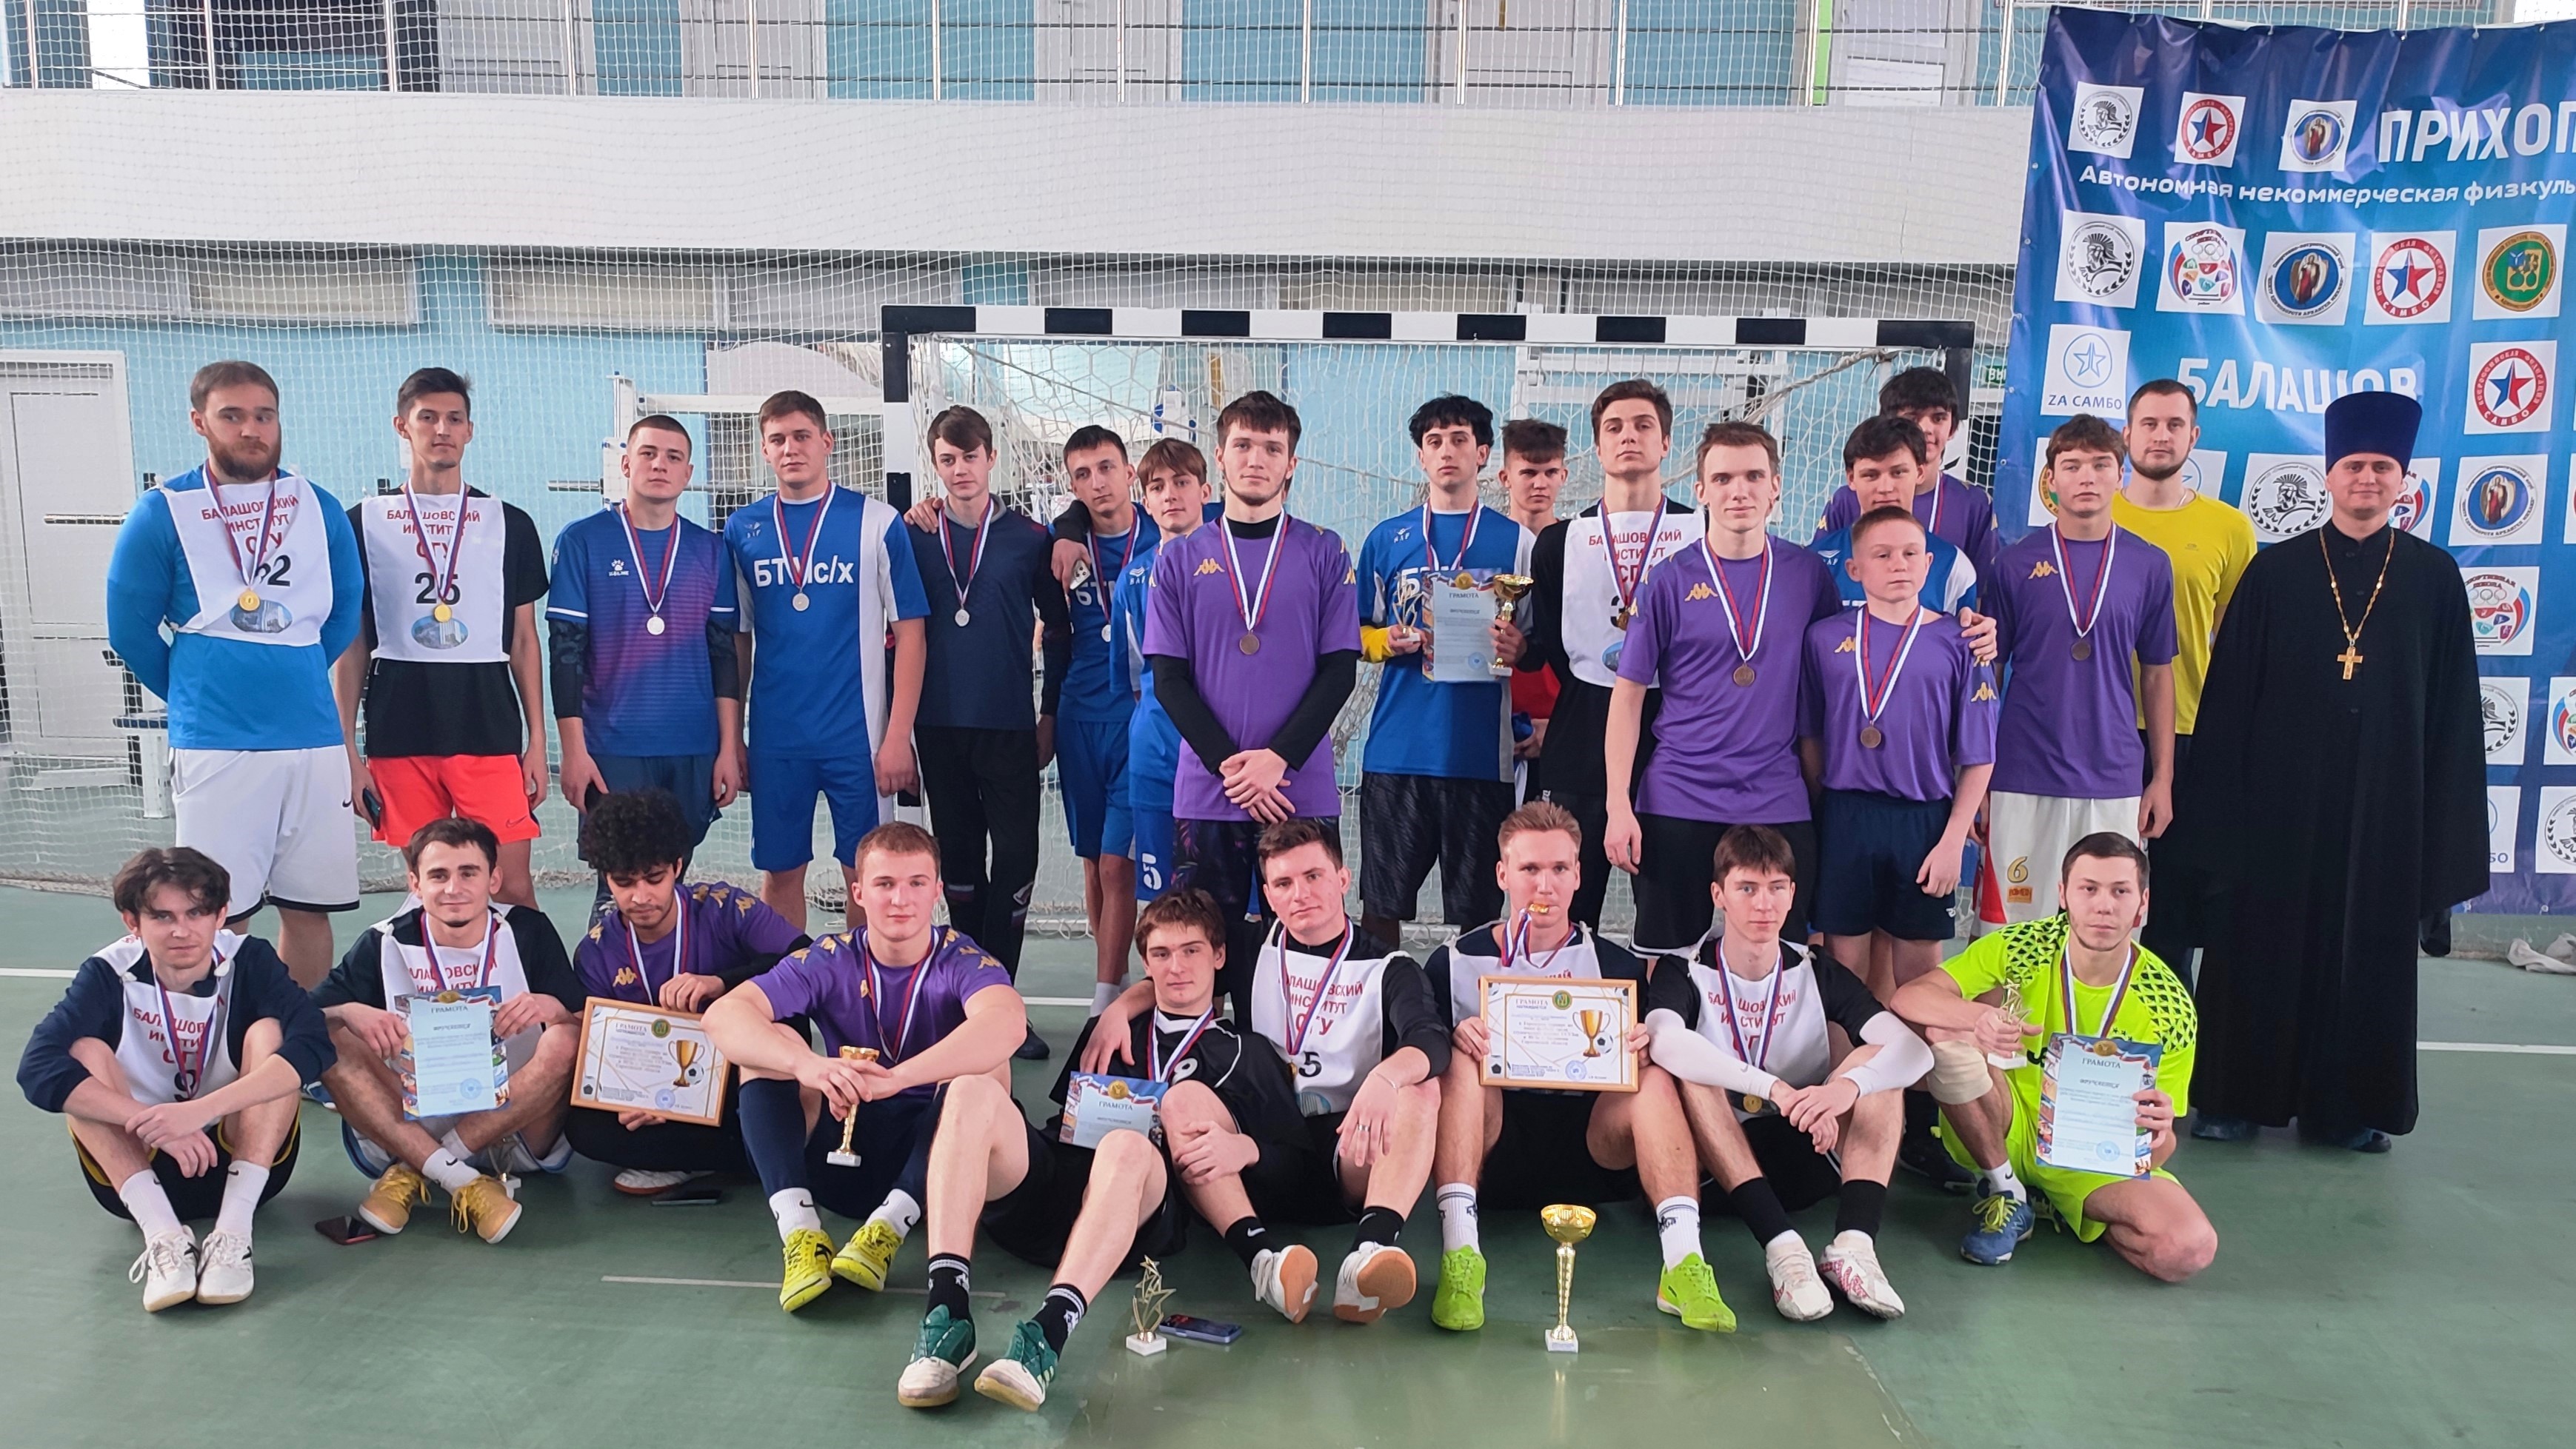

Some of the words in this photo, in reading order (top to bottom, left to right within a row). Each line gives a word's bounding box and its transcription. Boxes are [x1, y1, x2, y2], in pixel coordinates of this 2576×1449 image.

[2079, 165, 2233, 198] Автономная
[2238, 185, 2459, 208] некоммерческая
[2463, 180, 2576, 207] физкуль
[2383, 300, 2430, 316] САМБО
[2048, 394, 2067, 407] ZA
[2072, 395, 2123, 410] САМБО
[2484, 409, 2529, 426] САМБО
[225, 514, 290, 532] ИНСТТУТ
[387, 509, 481, 522] БАЛШОВСИЙ
[245, 532, 282, 555] СУ
[1589, 529, 1681, 546] БААШОВКИЙ
[415, 572, 461, 605] 25
[1142, 853, 1162, 891] 5
[2006, 856, 2029, 884] 6
[431, 1005, 469, 1014] ГРАМОТА
[1290, 994, 1347, 1014] ИНСИТУТ
[1708, 989, 1796, 1013] БАЛШОВКИЙ
[1296, 1013, 1334, 1036] СУ
[1721, 1012, 1786, 1028] ИСТИУТ
[1298, 1051, 1322, 1078] 5
[2082, 1057, 2120, 1068] ГРАМОТА
[1099, 1100, 1133, 1111] ГРАМОТА
